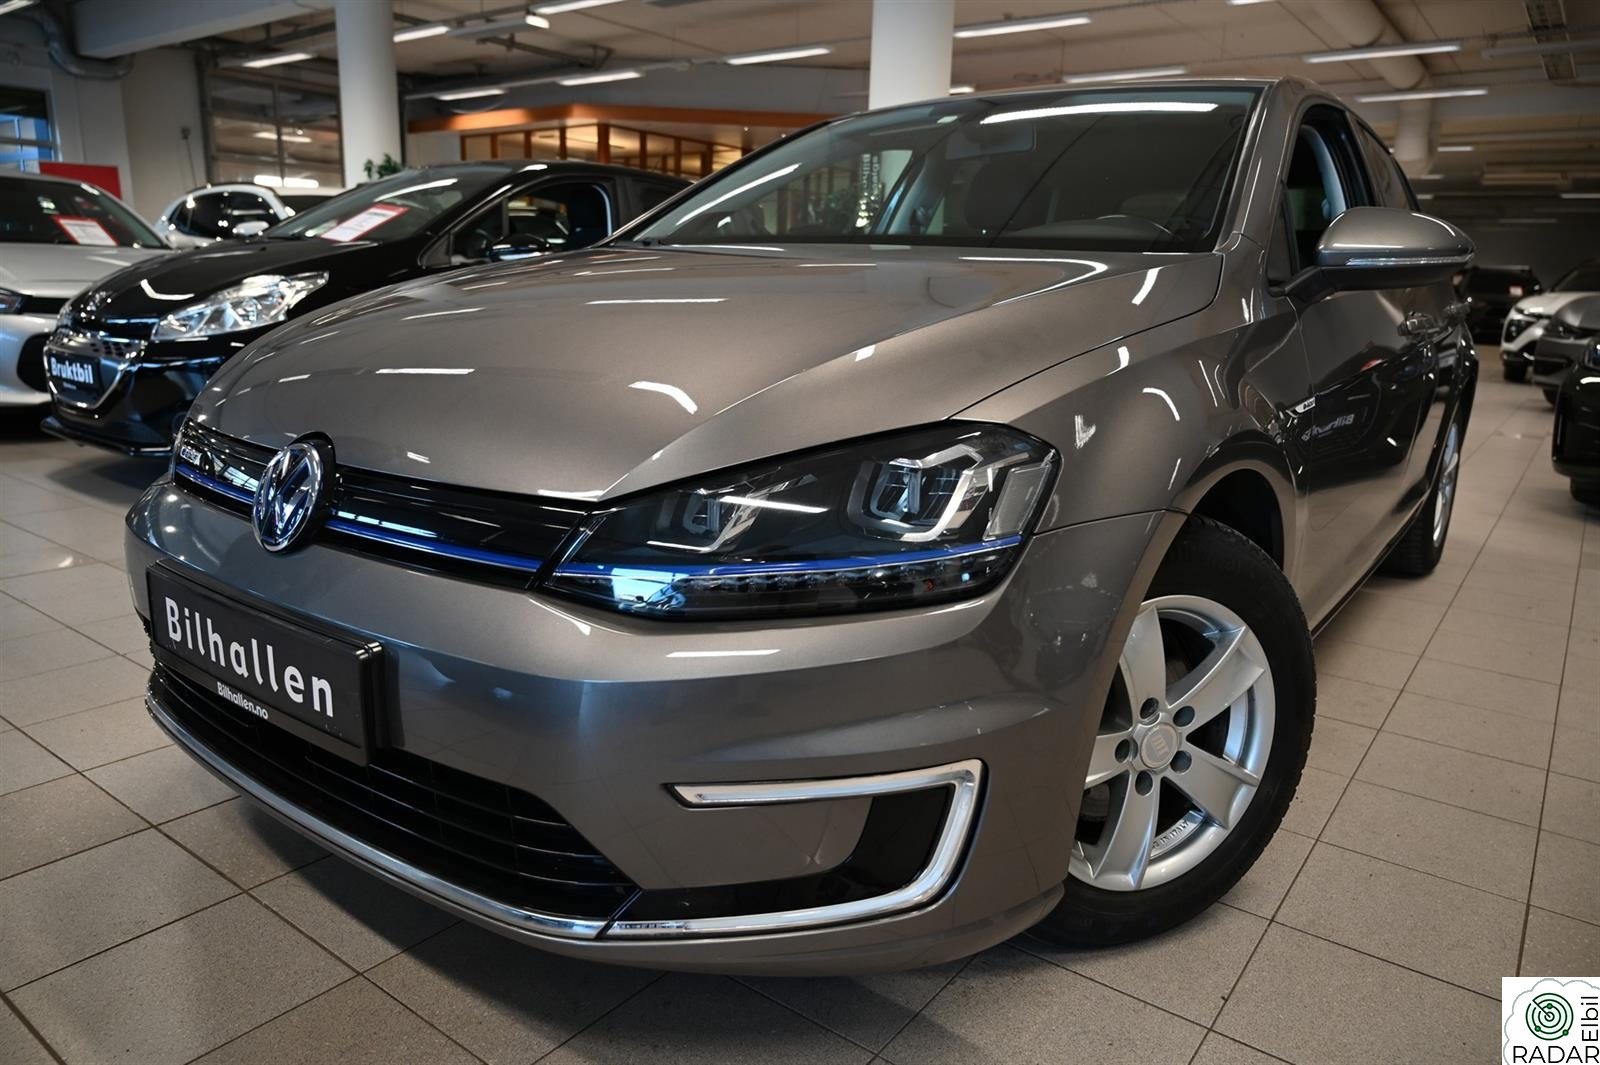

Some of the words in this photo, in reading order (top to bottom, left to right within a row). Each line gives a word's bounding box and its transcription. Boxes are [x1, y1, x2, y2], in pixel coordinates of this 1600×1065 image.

[50, 356, 94, 384] Bruktbil
[165, 596, 334, 718] Bilhallen
[217, 681, 269, 720] Bilhallen.no
